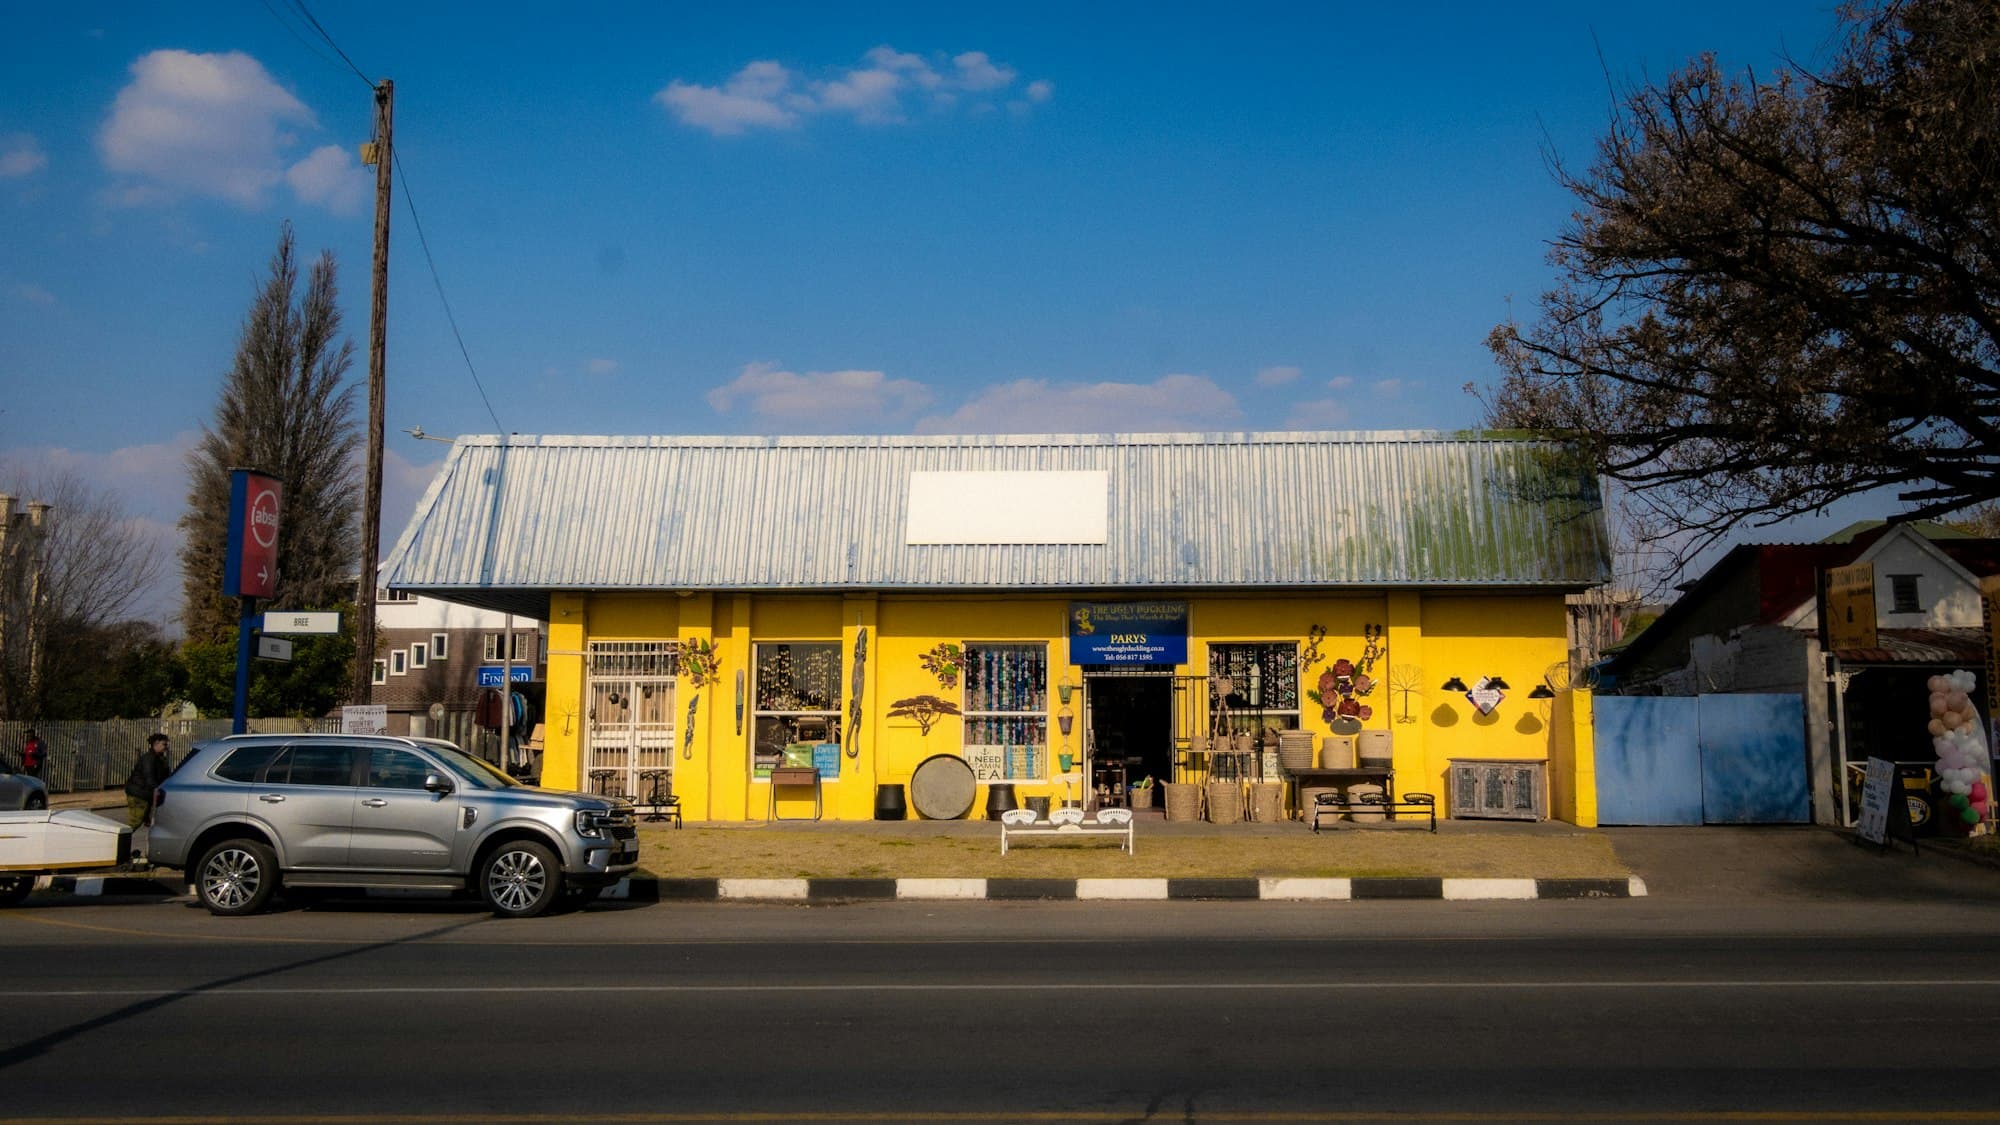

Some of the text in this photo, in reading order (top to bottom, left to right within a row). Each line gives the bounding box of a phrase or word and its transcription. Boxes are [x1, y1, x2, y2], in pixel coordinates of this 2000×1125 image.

[256, 506, 278, 527] absa
[1092, 605, 1184, 613] THE UGLY DUCKLING
[1110, 634, 1147, 644] PARYS
[1092, 645, 1165, 653] www.theuglyduckling.co.za
[1982, 596, 1998, 709] DROOMVROU
[1116, 653, 1126, 661] 056
[1128, 653, 1138, 661] 817
[974, 755, 1001, 763] NEED
[973, 769, 1001, 780] EA
